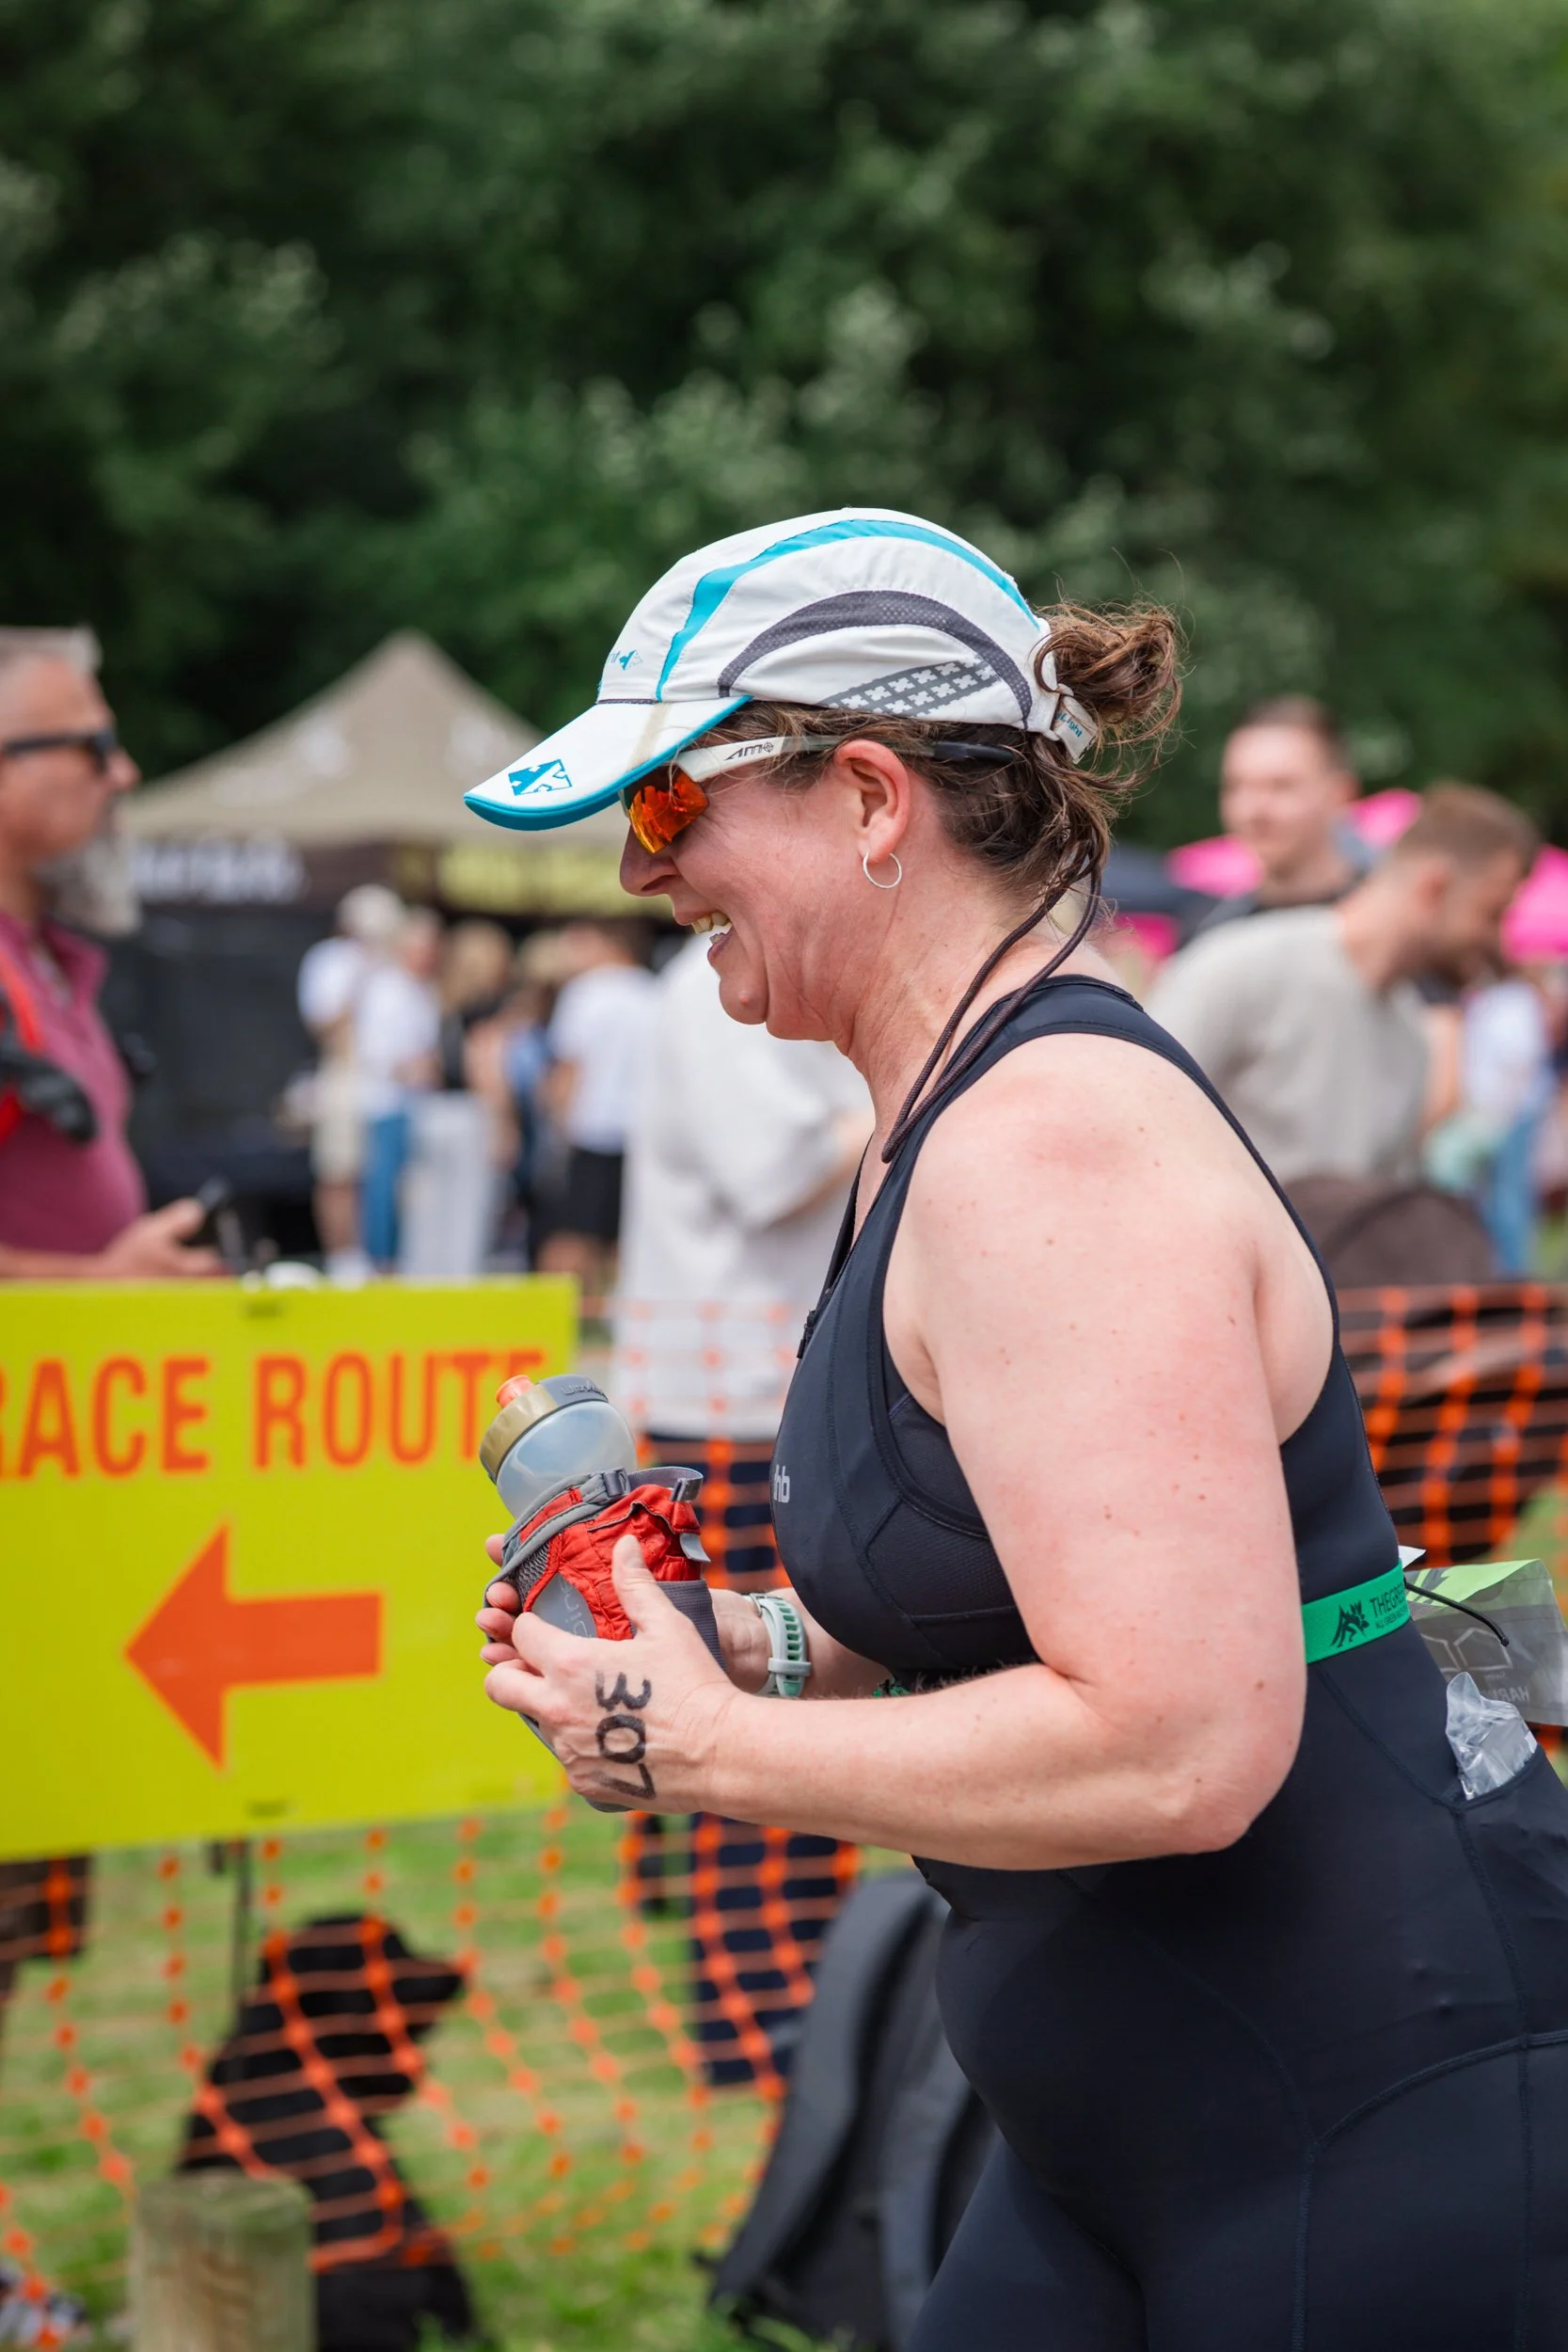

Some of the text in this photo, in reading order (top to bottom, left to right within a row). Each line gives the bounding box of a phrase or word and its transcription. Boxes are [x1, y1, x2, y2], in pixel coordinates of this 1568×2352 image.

[0, 1356, 210, 1481] ACE
[773, 1464, 790, 1502] hb
[592, 1670, 657, 1800] 307
